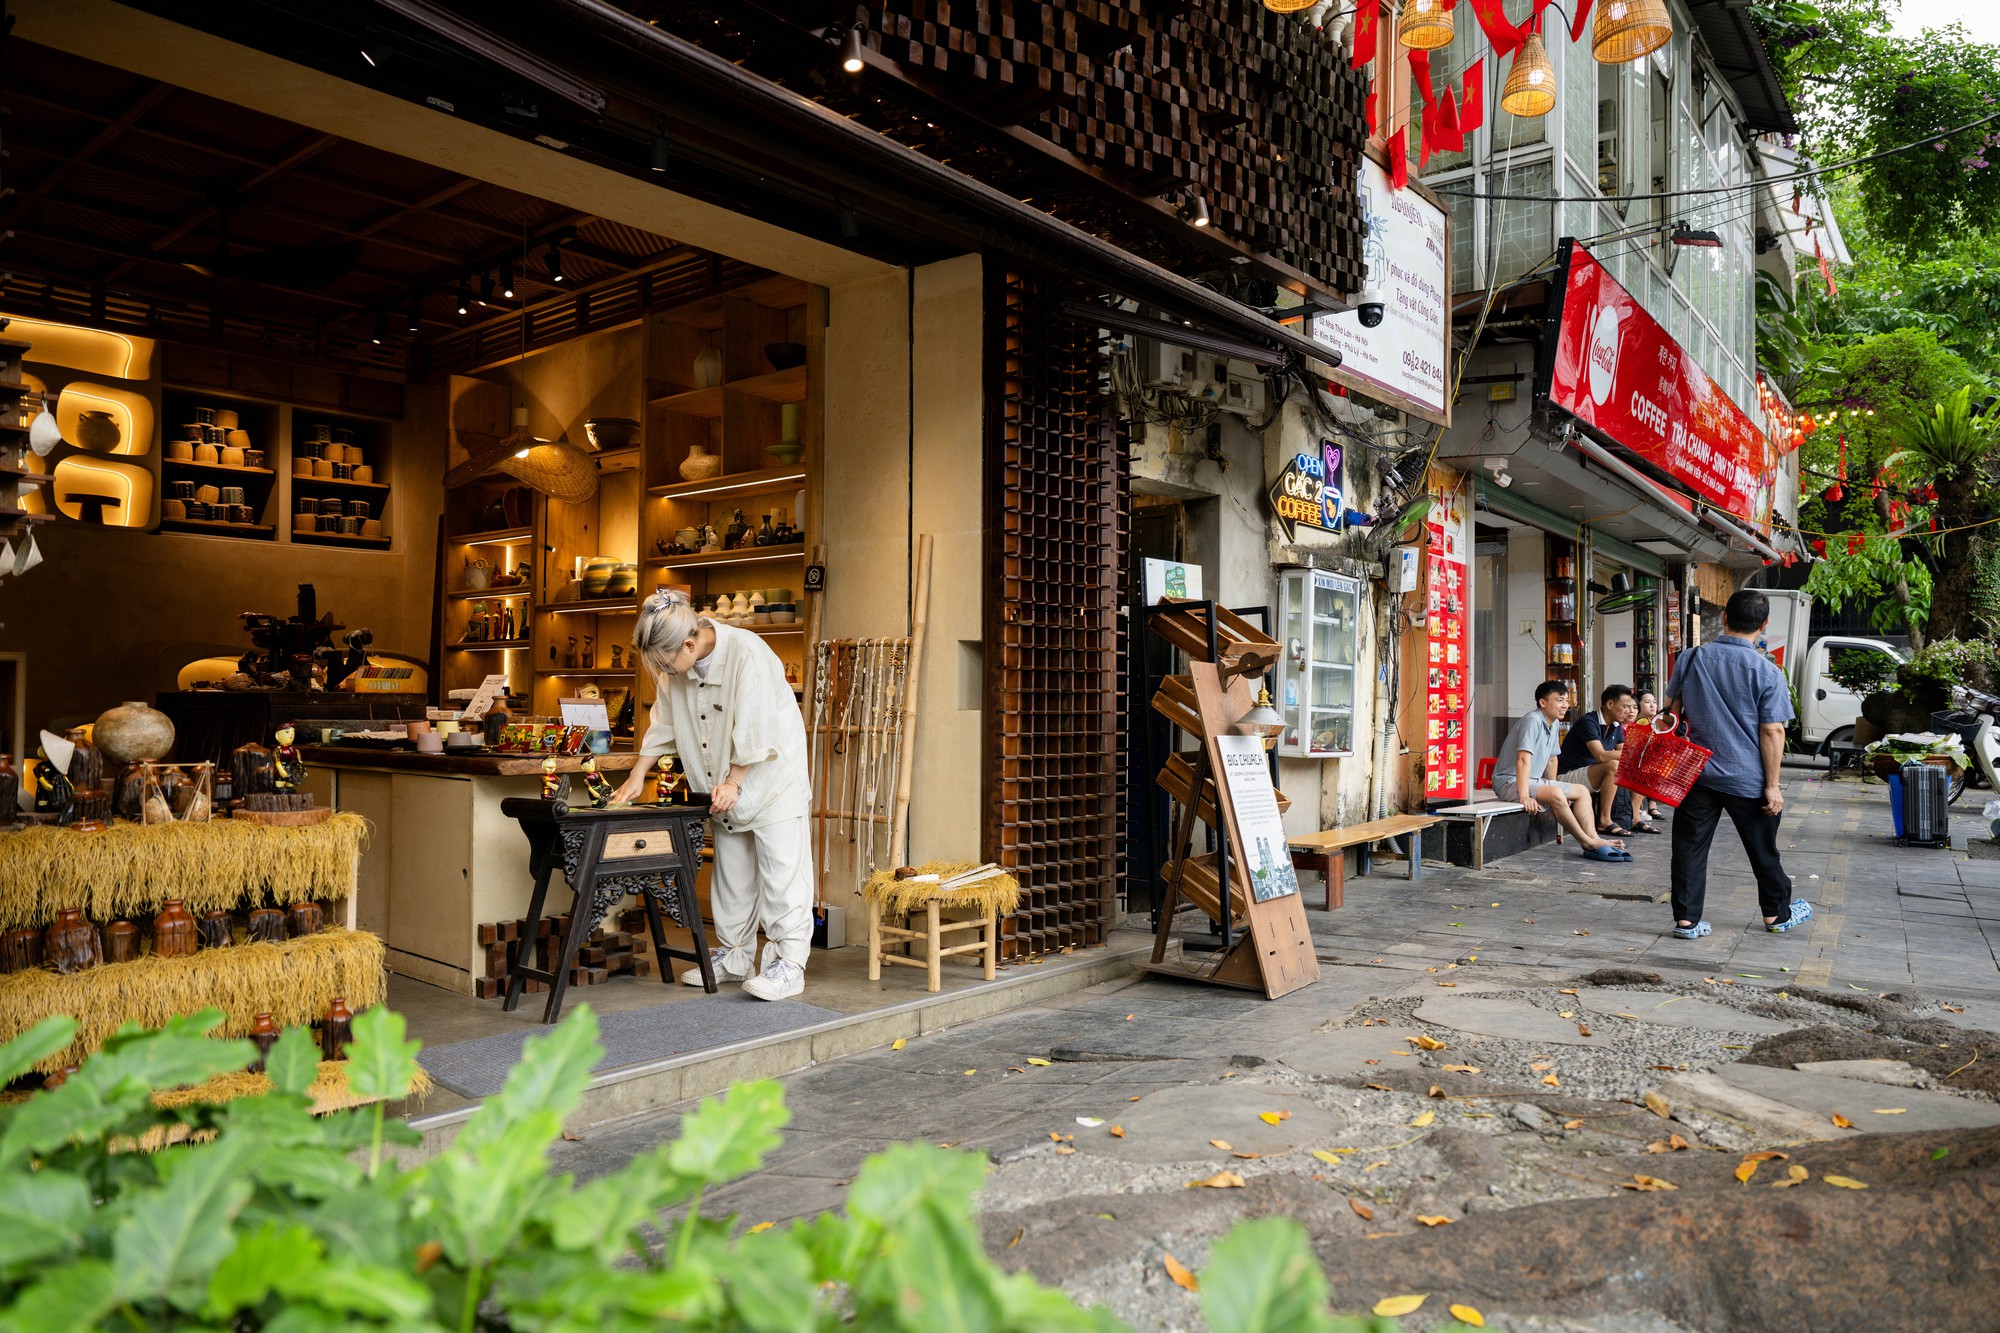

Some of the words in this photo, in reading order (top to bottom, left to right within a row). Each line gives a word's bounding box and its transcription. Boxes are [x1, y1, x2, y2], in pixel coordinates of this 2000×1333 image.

[1386, 257, 1390, 271] Y
[1390, 262, 1404, 281] phục
[1404, 269, 1410, 283] và
[1417, 299, 1429, 321] Công
[1320, 331, 1328, 340] Kim
[1325, 319, 1334, 330] Nhà
[1420, 360, 1431, 376] 421
[1631, 389, 1668, 438] COFFEE
[1687, 432, 1711, 466] CHANH
[1712, 451, 1727, 478] SINH
[1298, 454, 1324, 477] OPEN
[1284, 470, 1312, 500] GÁC
[1314, 480, 1323, 504] 2
[1277, 495, 1323, 526] COFFEE
